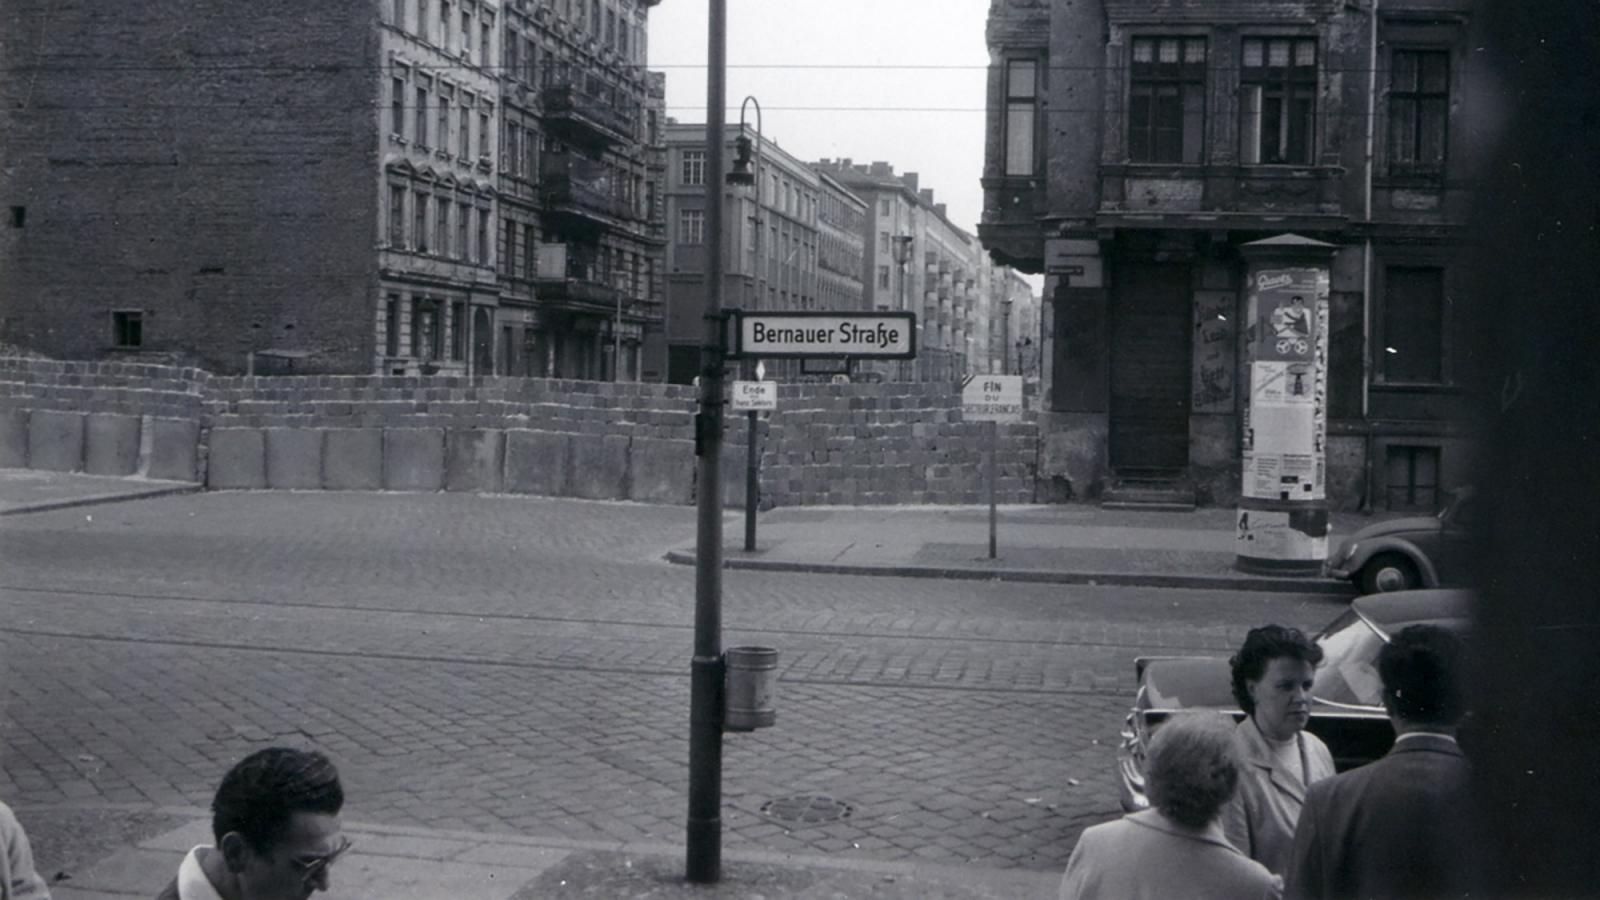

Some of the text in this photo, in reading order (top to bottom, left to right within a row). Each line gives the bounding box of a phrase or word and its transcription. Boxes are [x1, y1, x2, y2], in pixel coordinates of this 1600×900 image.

[753, 322, 899, 348] Bernauer Straße
[742, 384, 766, 394] Ende
[983, 380, 1002, 392] FIN
[984, 394, 1000, 402] DU
